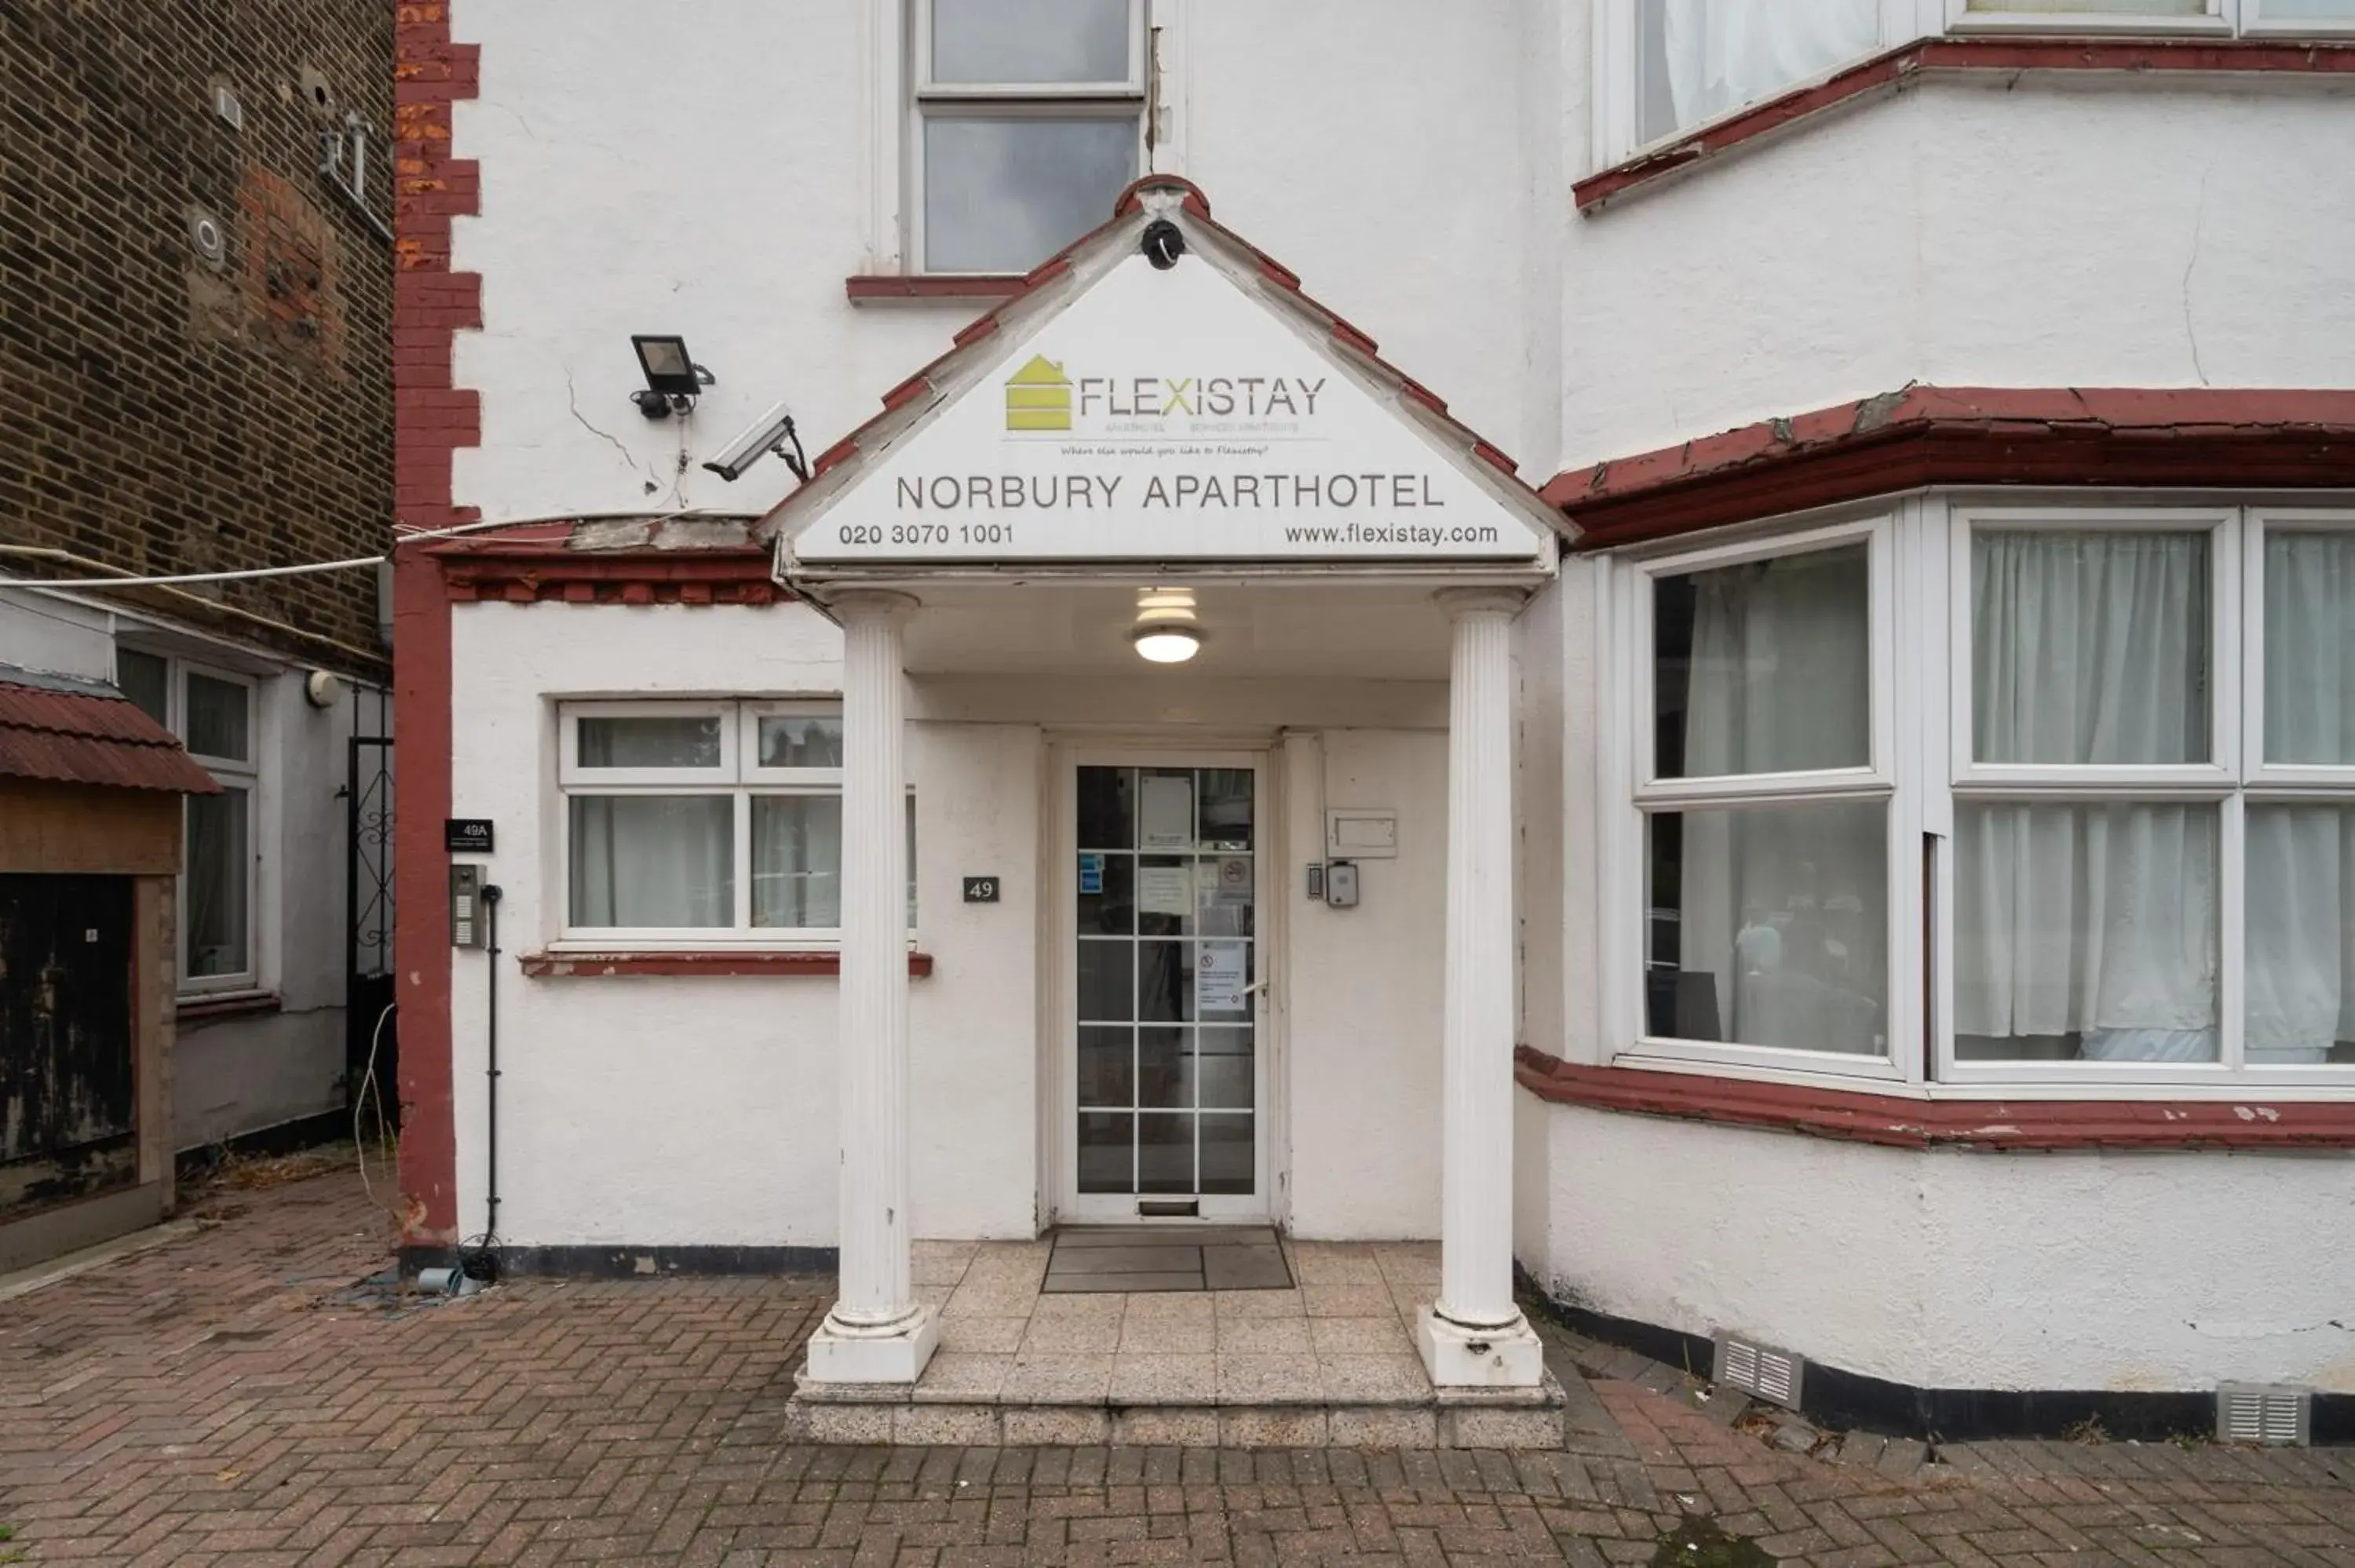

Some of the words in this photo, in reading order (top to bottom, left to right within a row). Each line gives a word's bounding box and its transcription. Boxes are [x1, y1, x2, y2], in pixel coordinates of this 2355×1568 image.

[1080, 377, 1327, 416] FLEXISTAY
[896, 475, 1123, 510] NORBURY
[1141, 473, 1445, 509] APARTHOTEL
[838, 524, 883, 545] 020
[891, 524, 950, 545] 3070
[959, 523, 1013, 544] 1001
[1284, 522, 1499, 547] www.flexistay.com
[463, 824, 488, 837] 49A
[969, 881, 994, 899] 49
